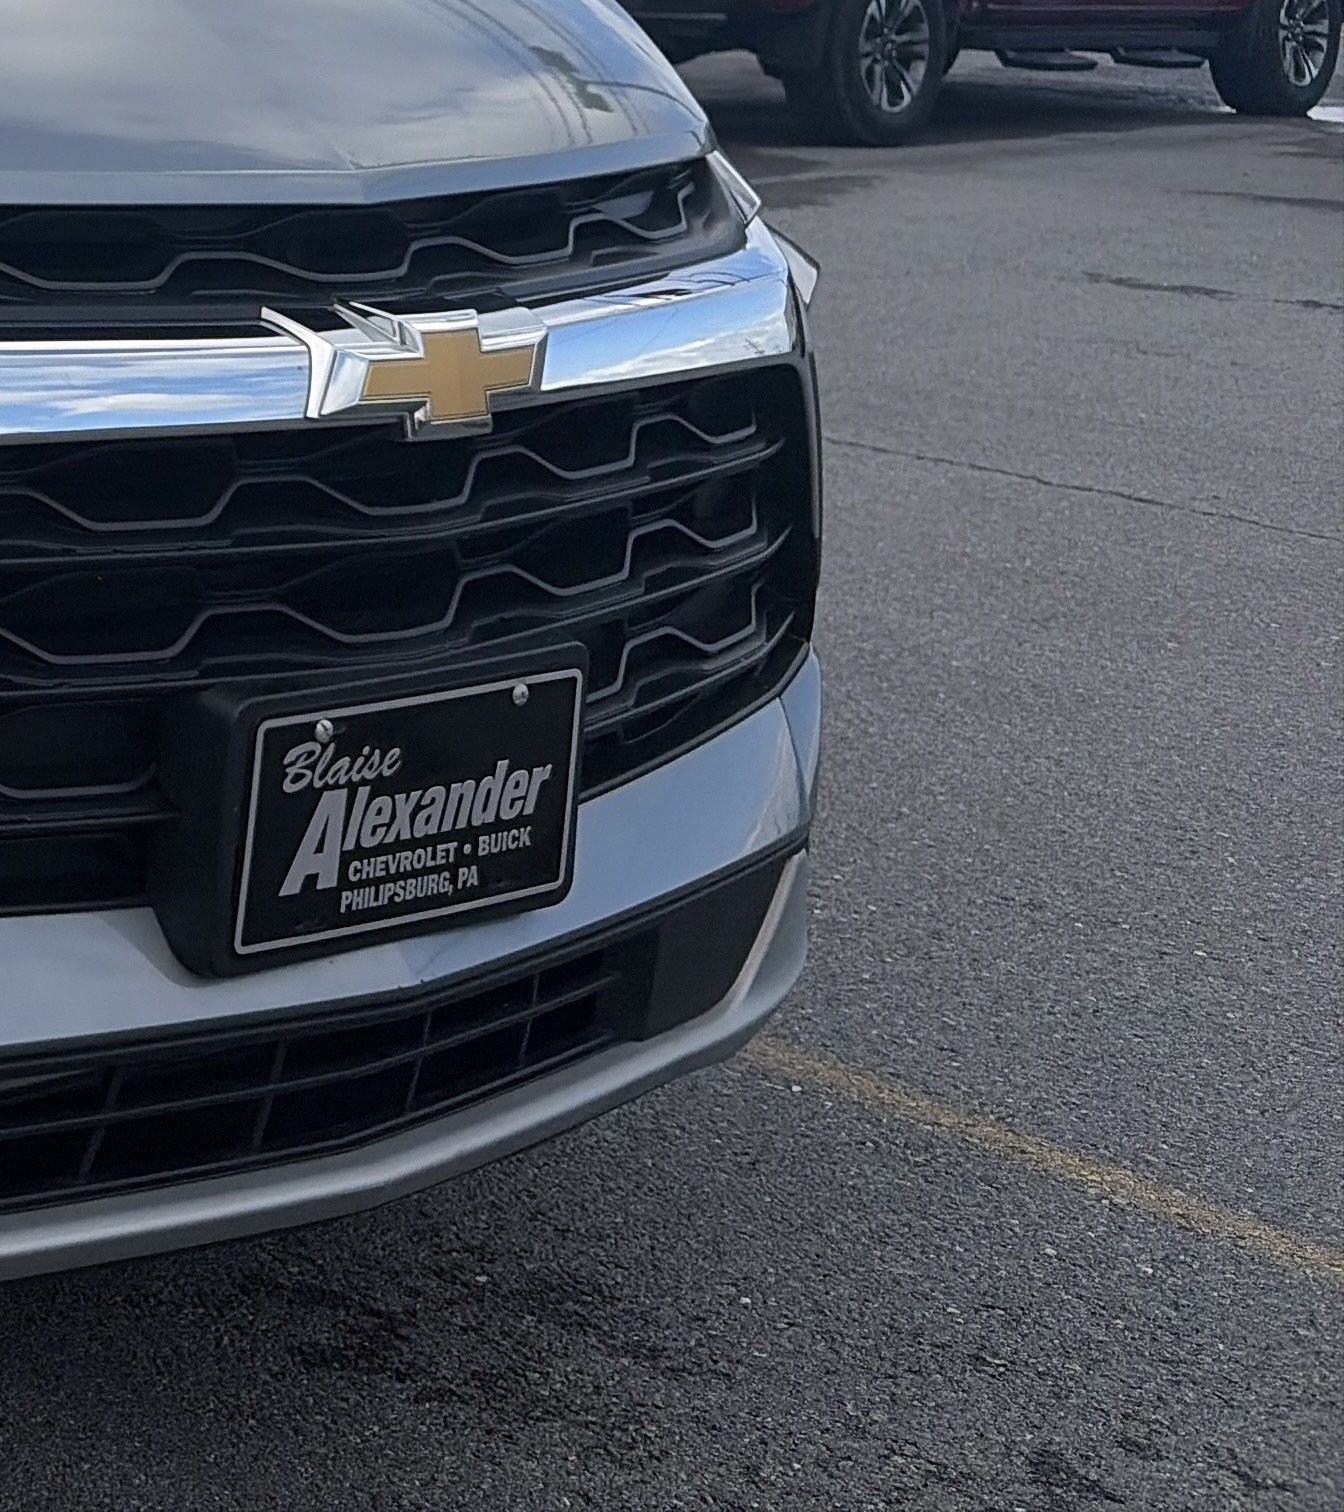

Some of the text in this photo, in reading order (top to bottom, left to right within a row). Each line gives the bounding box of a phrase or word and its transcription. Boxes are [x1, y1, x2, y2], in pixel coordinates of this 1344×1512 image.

[282, 741, 403, 794] Blaise
[277, 759, 553, 898] Alexander
[347, 825, 533, 882] CHEVROLET BUICK
[339, 865, 479, 914] PHILIPSBURG, PA
